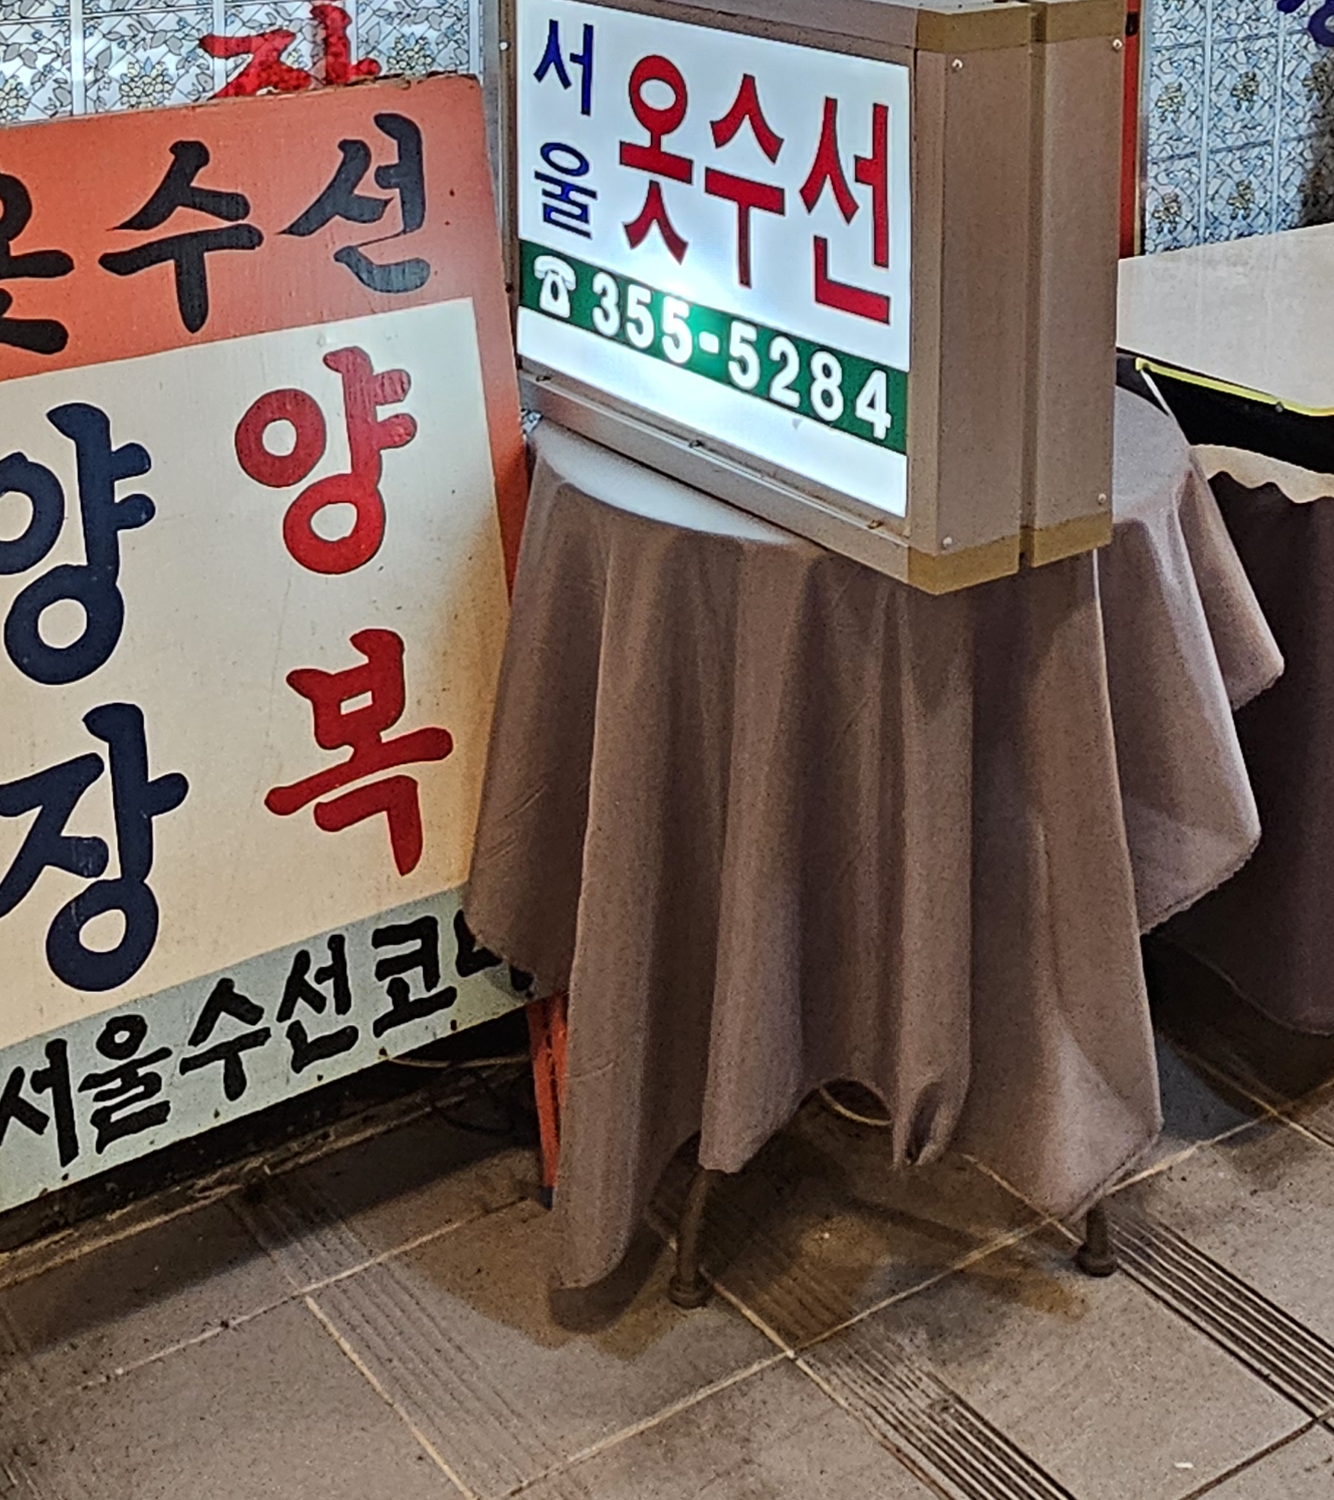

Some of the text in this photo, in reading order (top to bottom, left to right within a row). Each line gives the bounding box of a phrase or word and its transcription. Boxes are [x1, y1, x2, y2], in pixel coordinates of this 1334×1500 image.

[533, 18, 599, 240] 서울
[618, 53, 892, 326] 옷수선
[591, 278, 893, 442] 355-5284
